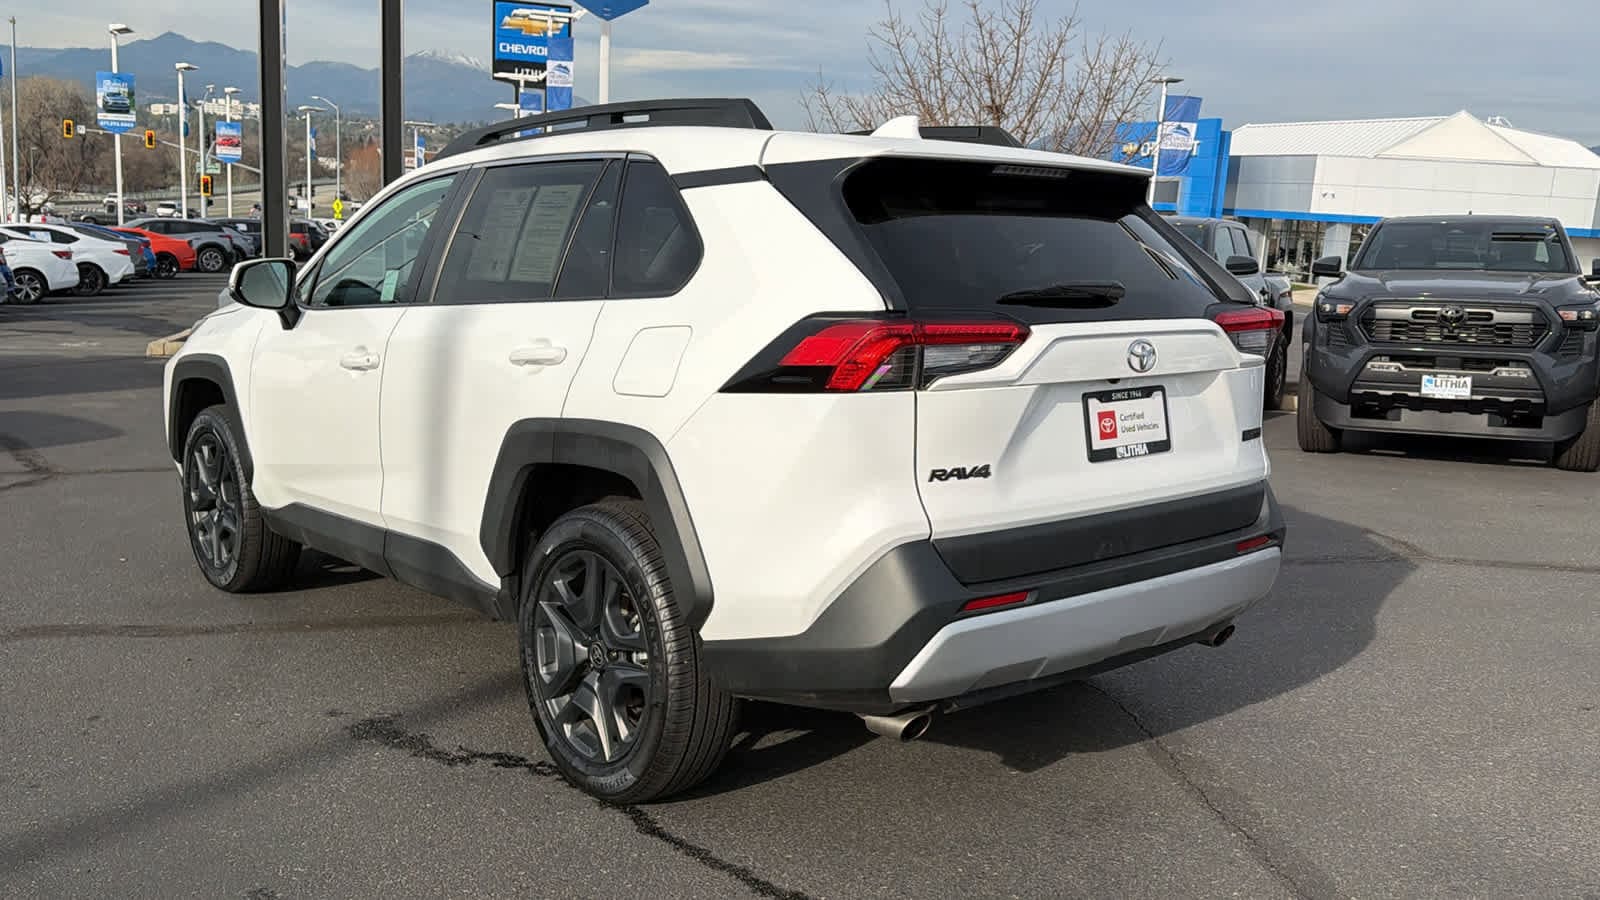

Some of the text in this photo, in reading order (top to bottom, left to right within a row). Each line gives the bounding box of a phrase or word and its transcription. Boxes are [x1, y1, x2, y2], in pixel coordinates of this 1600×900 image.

[499, 42, 548, 57] CHEVRO
[1434, 379, 1469, 389] LITHIA
[1111, 391, 1129, 400] SINCE
[1120, 411, 1145, 421] Certified
[1121, 422, 1160, 433] Used Vehicles
[1124, 443, 1149, 457] LITHIA
[928, 464, 992, 482] RAV4
